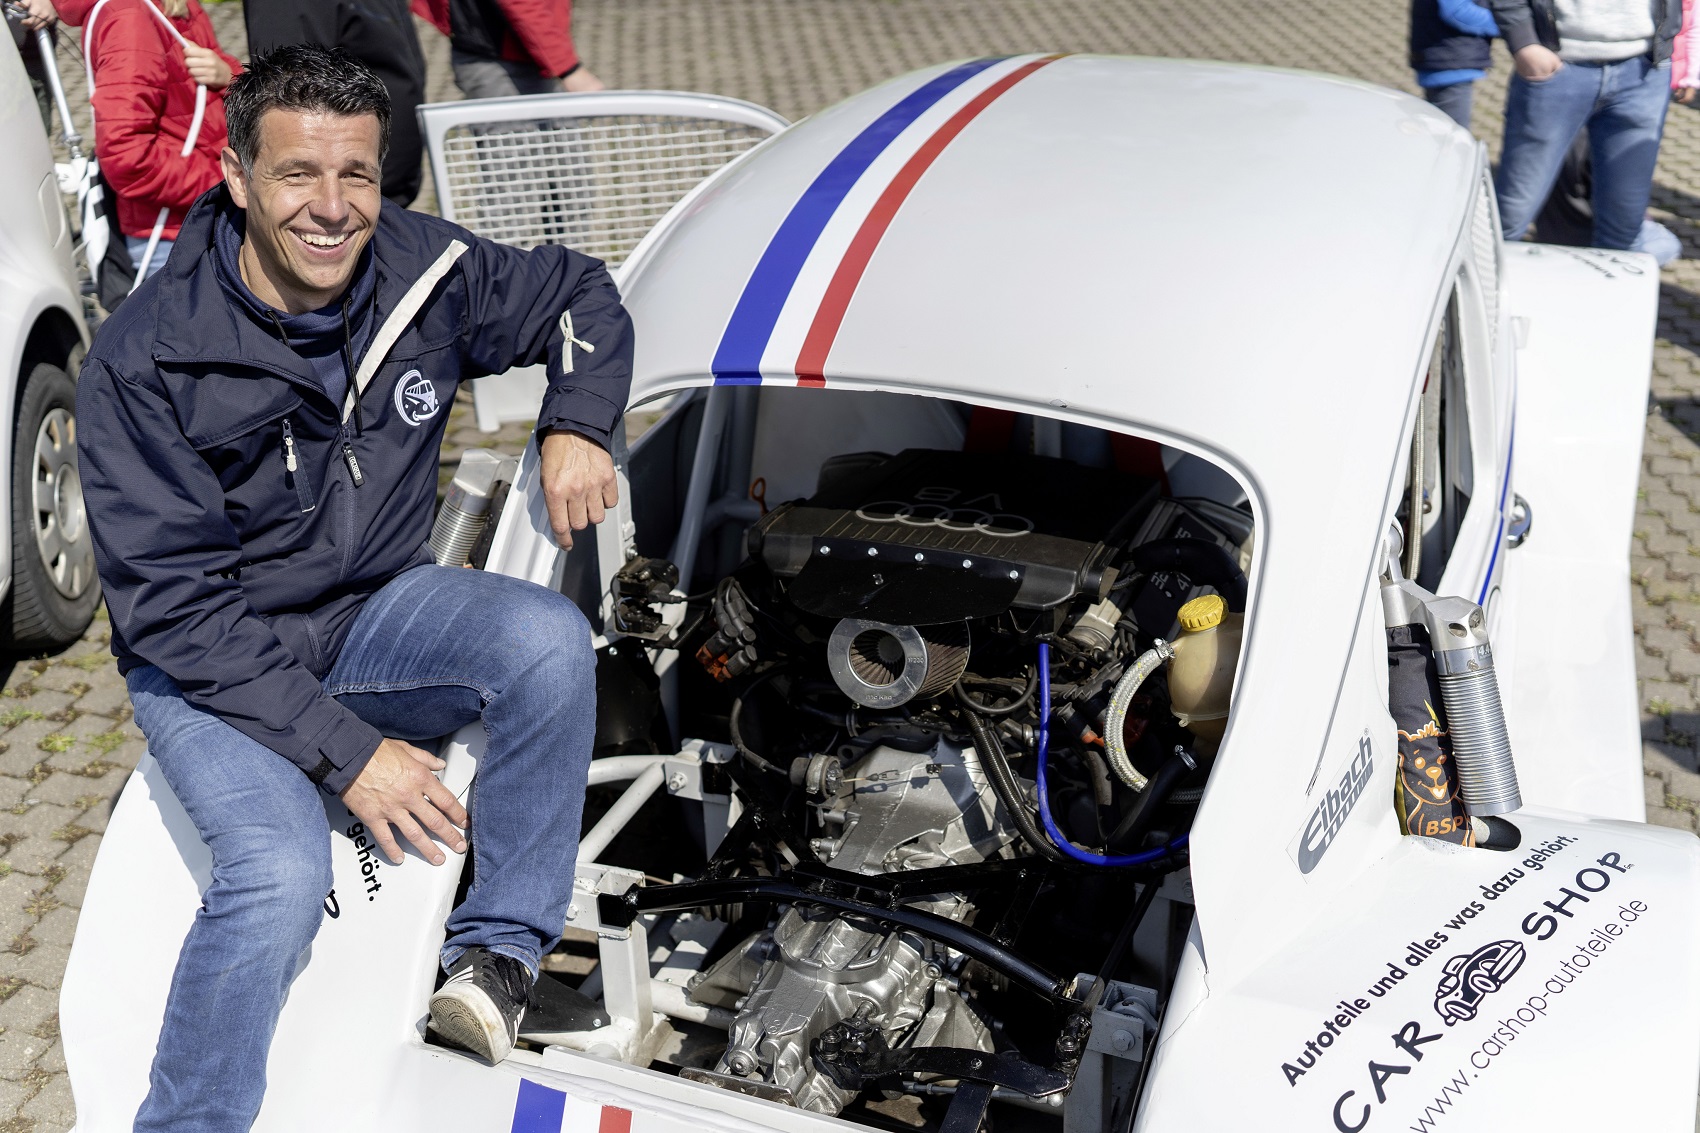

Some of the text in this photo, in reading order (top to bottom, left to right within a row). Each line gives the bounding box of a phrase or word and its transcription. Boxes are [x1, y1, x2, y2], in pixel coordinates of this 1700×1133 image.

[346, 822, 382, 902] gehört.
[1298, 736, 1373, 874] Eibach
[1425, 815, 1464, 836] BSP
[1280, 835, 1579, 1087] Autoteile und alles was dazu gehört.
[1332, 851, 1627, 1133] CAR SHOP
[1410, 899, 1648, 1133] www.carshop-autoteile.de
